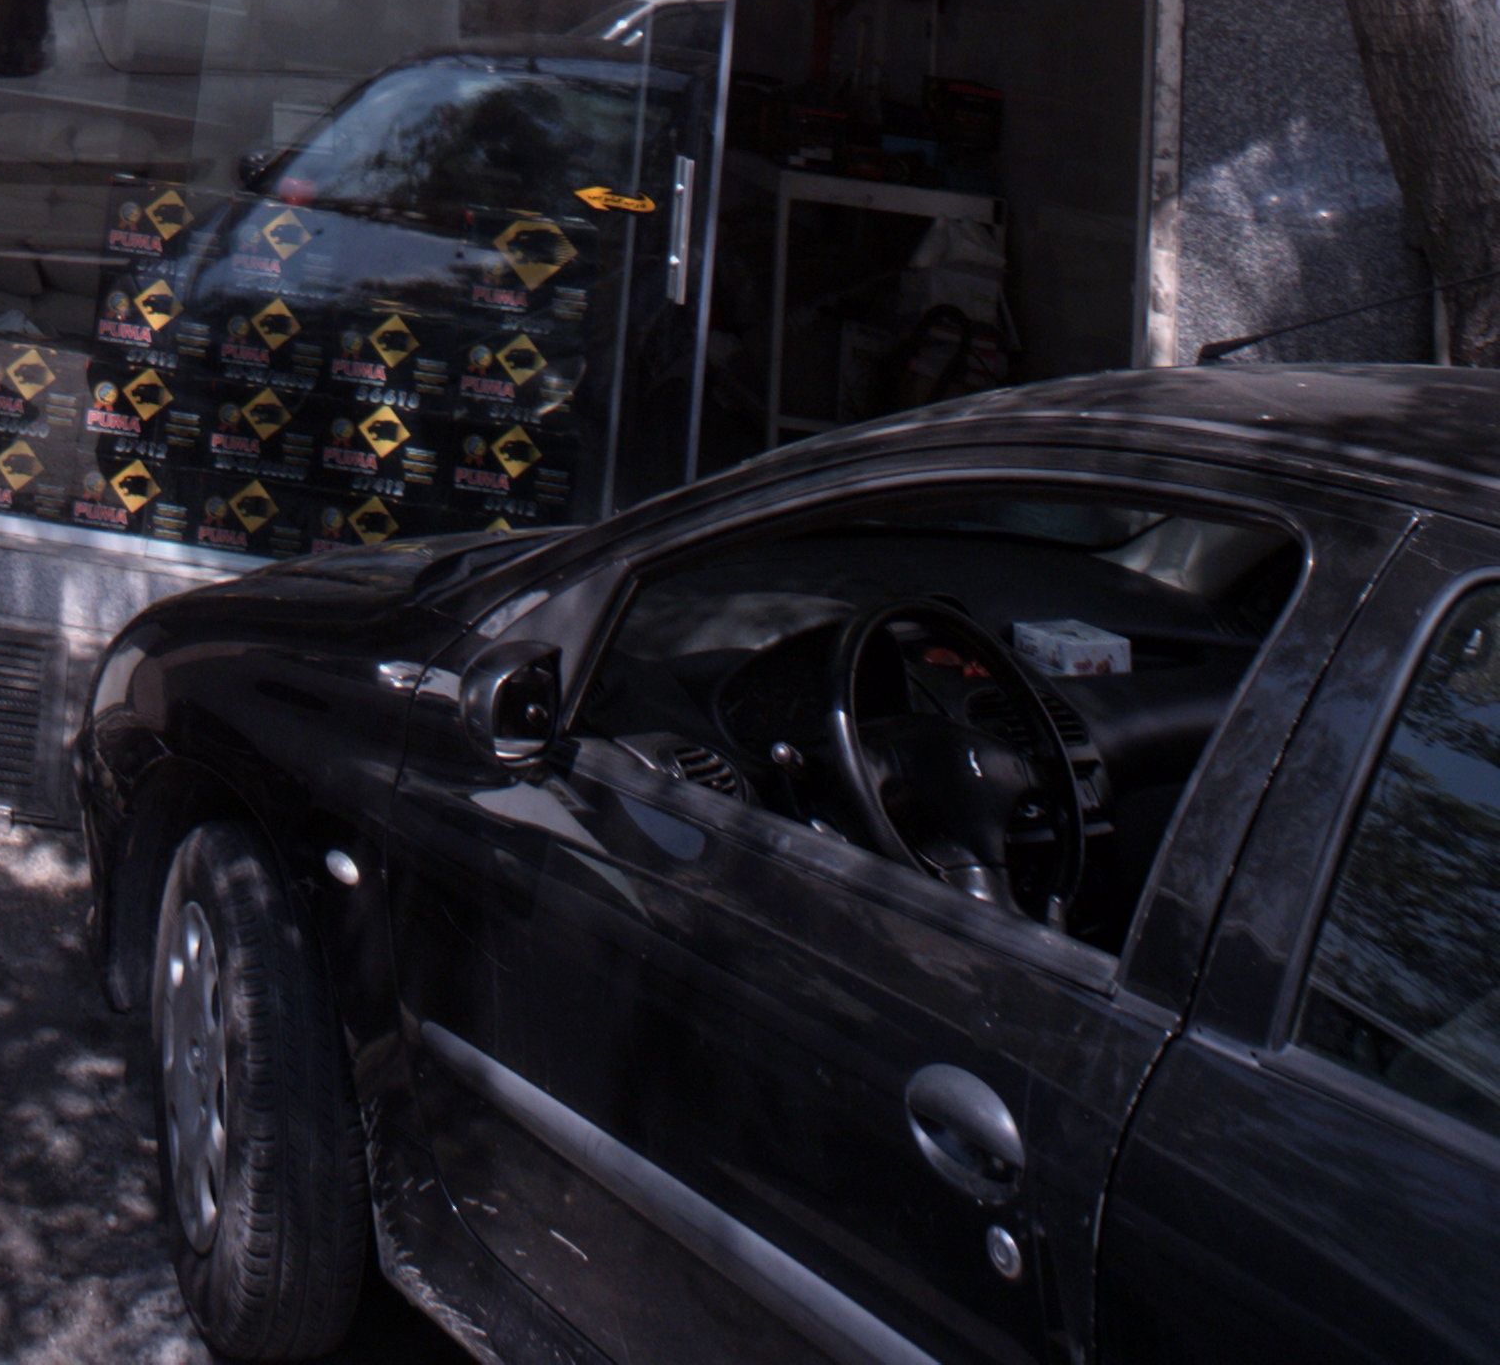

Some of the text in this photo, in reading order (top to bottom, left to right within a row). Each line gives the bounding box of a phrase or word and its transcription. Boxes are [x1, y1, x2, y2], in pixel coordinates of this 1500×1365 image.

[109, 229, 164, 253] PUMA
[99, 320, 152, 342] PUMA
[332, 360, 387, 382] PUMA
[460, 375, 515, 399] PUMA
[87, 410, 141, 433] PUMA
[211, 433, 261, 454] PUMA
[323, 447, 378, 470] PUMA
[454, 467, 510, 491] PUMA
[73, 502, 128, 526] PUMA
[198, 526, 248, 546] PUMA
